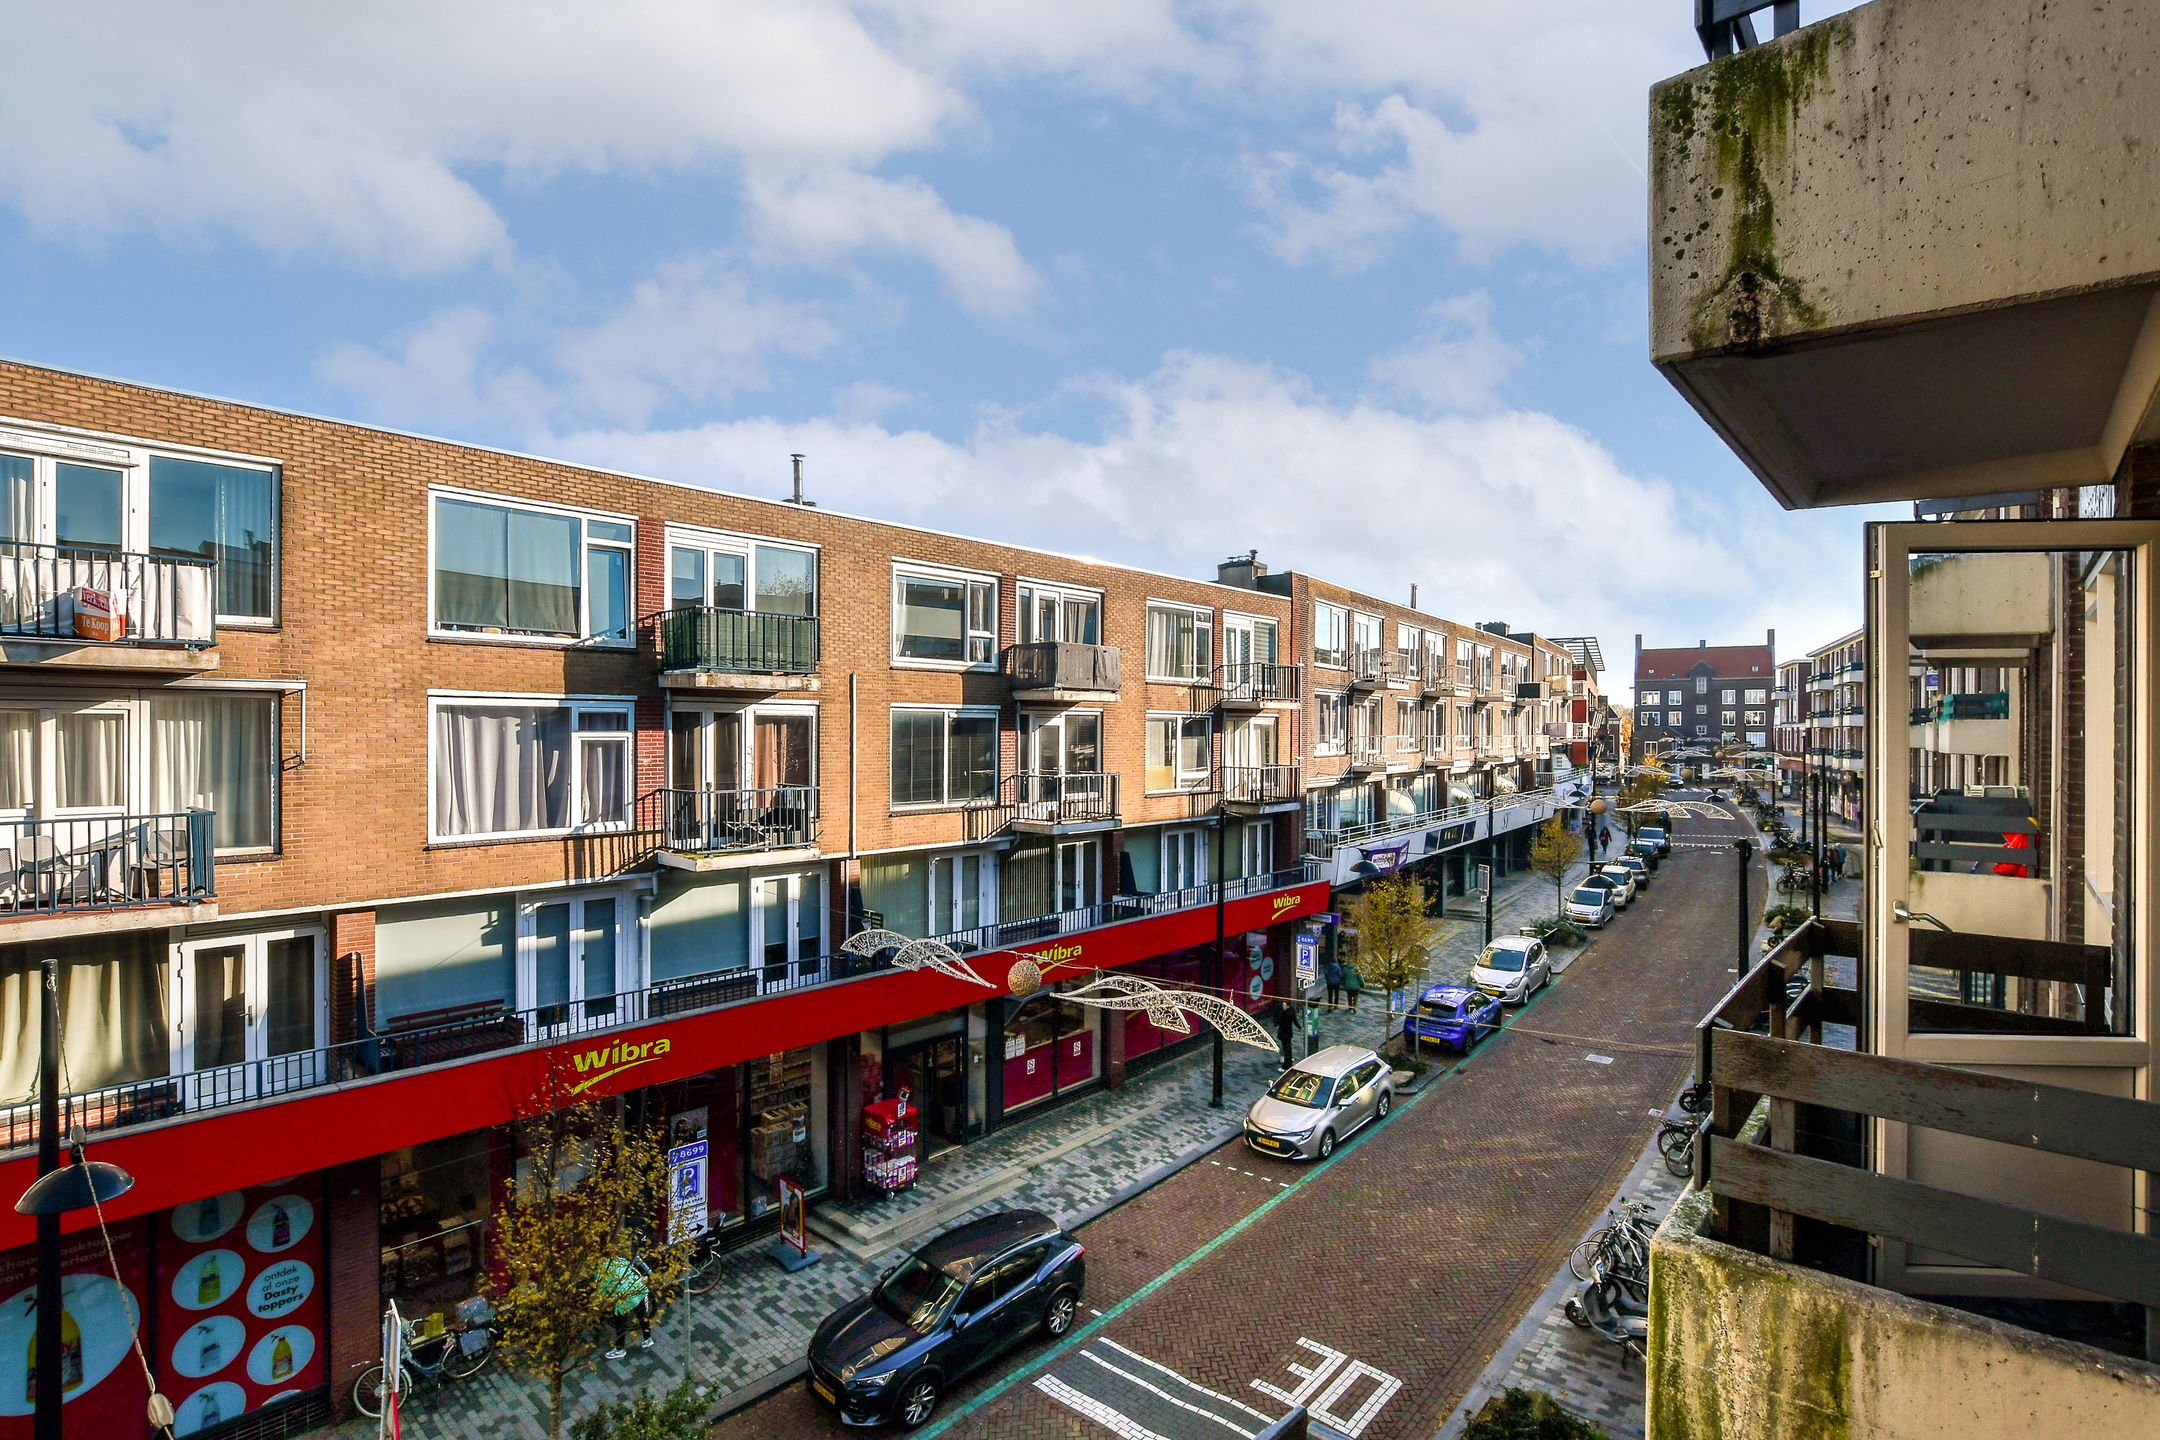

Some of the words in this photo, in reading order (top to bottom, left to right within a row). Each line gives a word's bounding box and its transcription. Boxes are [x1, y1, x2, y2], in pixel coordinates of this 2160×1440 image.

[82, 616, 91, 628] Te
[91, 618, 109, 634] Koop
[1273, 893, 1301, 909] Wibra
[1035, 943, 1082, 965] Wibra
[573, 1038, 671, 1073] Wibra
[680, 1146, 705, 1158] 8699
[264, 1264, 298, 1282] ontdek
[262, 1281, 272, 1292] al
[275, 1275, 300, 1288] onze
[264, 1285, 298, 1301] Dasty
[258, 1293, 304, 1313] toppers
[1249, 1336, 1403, 1440] 30
